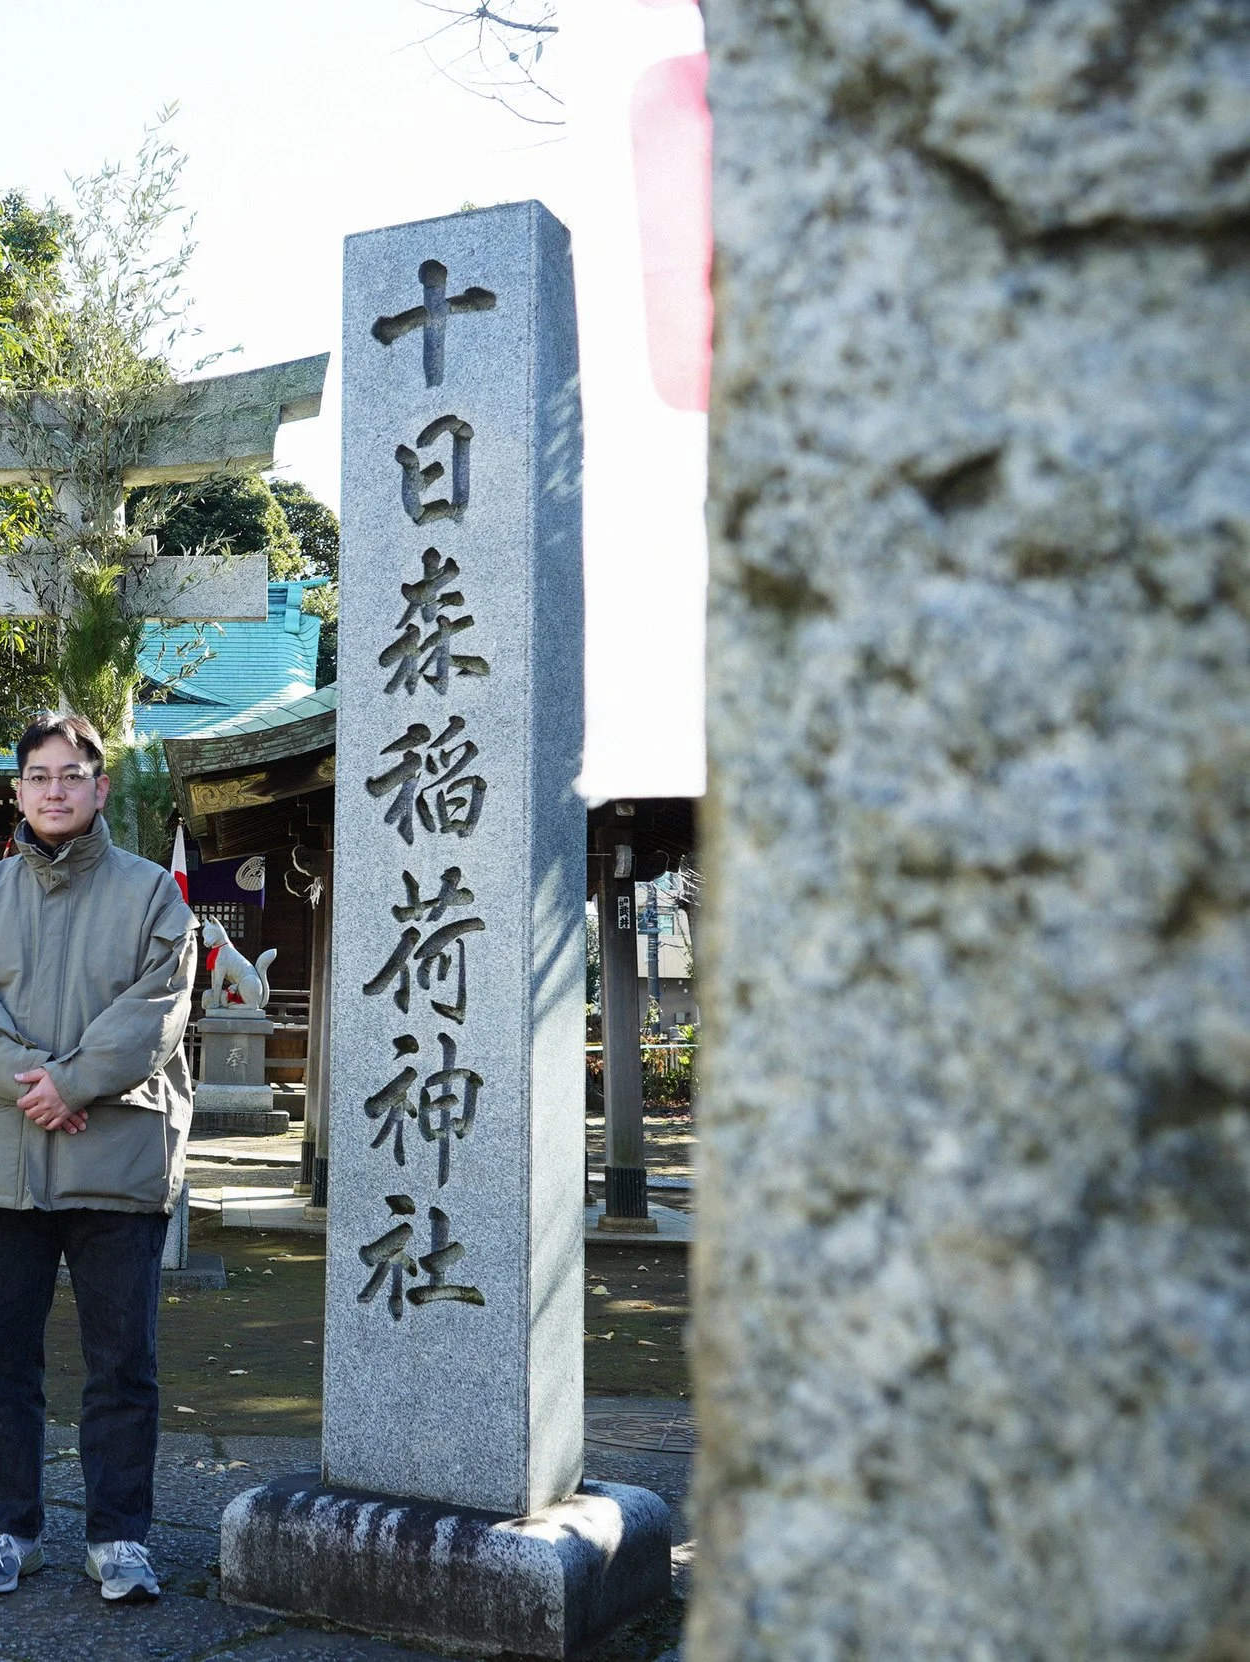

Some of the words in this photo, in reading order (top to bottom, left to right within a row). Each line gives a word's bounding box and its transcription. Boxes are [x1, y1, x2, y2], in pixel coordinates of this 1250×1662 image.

[225, 1044, 248, 1072] 奉
[356, 258, 498, 1321] 十日森稲荷神社
